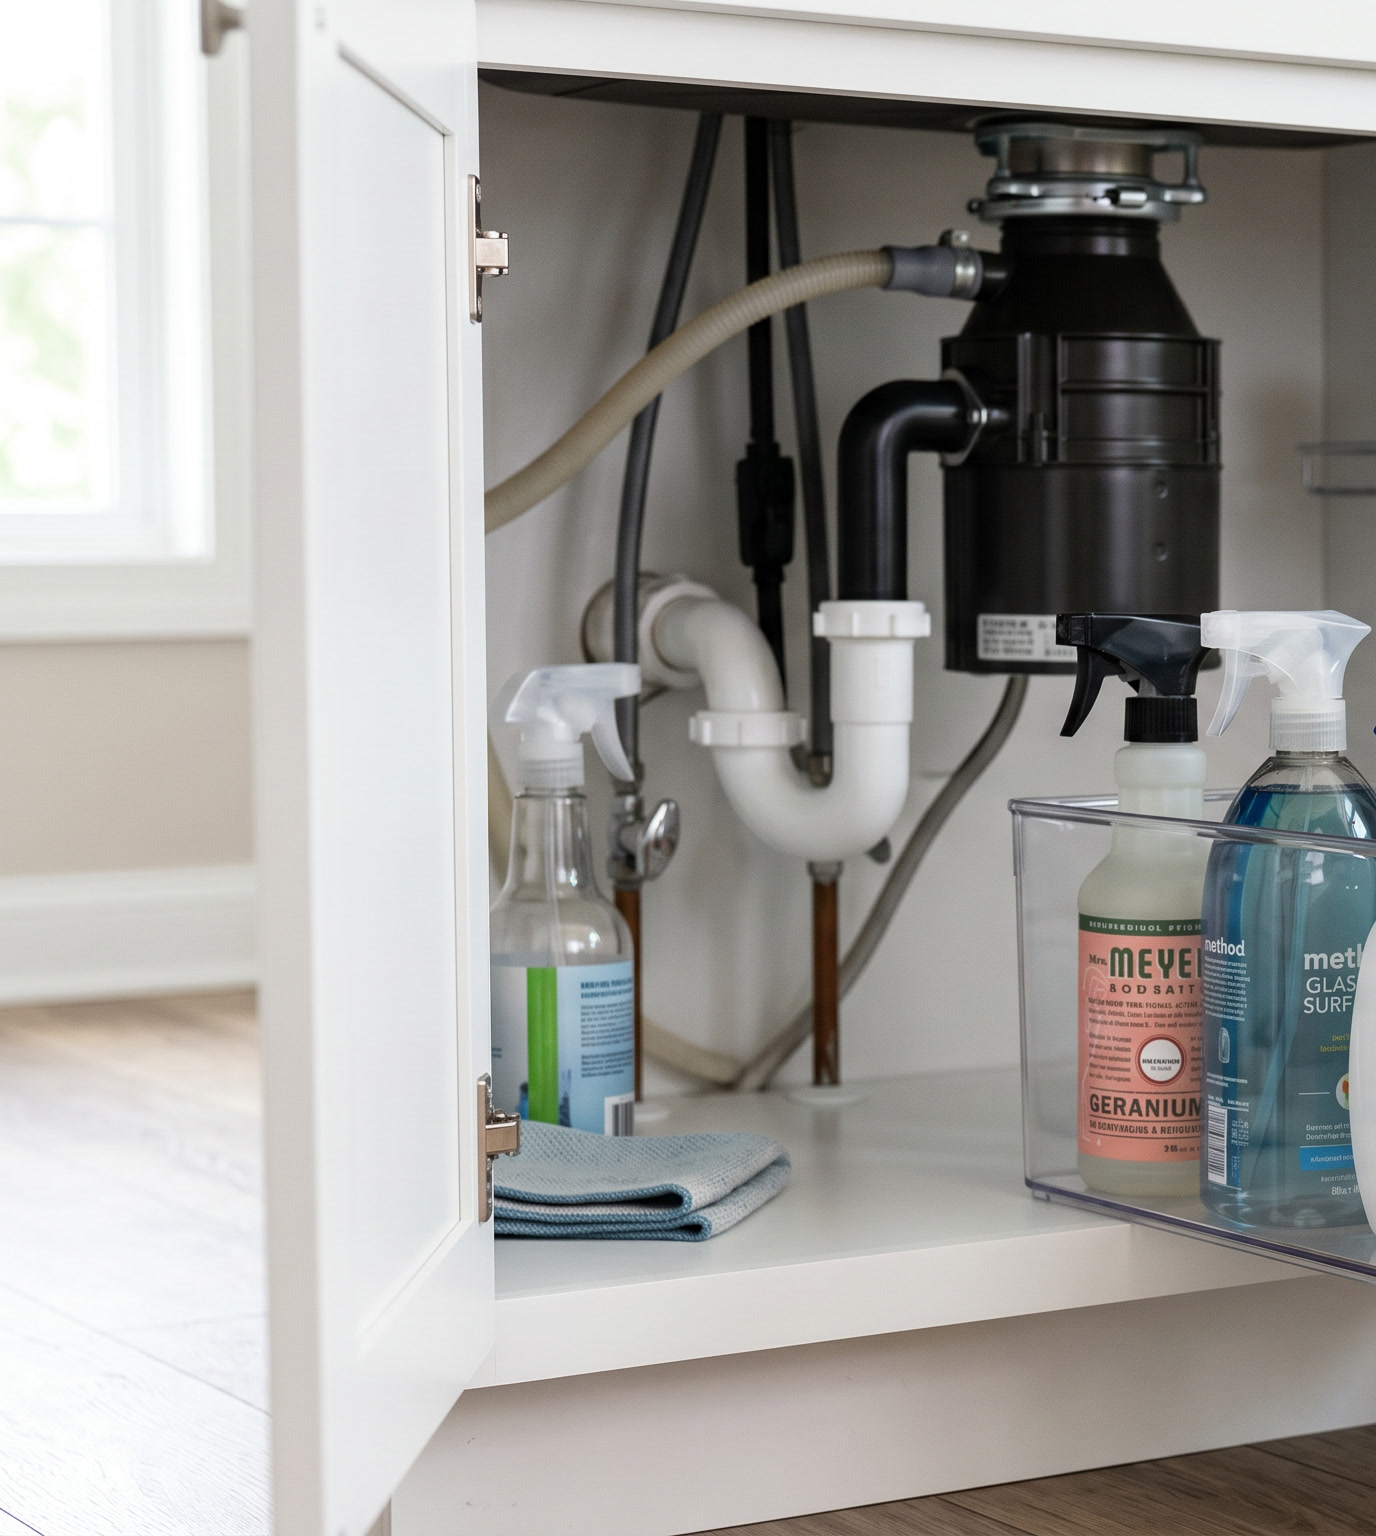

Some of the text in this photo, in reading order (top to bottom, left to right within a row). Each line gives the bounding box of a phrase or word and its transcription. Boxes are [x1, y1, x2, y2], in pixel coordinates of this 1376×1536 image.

[1204, 936, 1246, 957] method
[1306, 975, 1357, 994] GLAS
[1303, 995, 1353, 1014] SURF
[1089, 1093, 1202, 1118] GERANIUM
